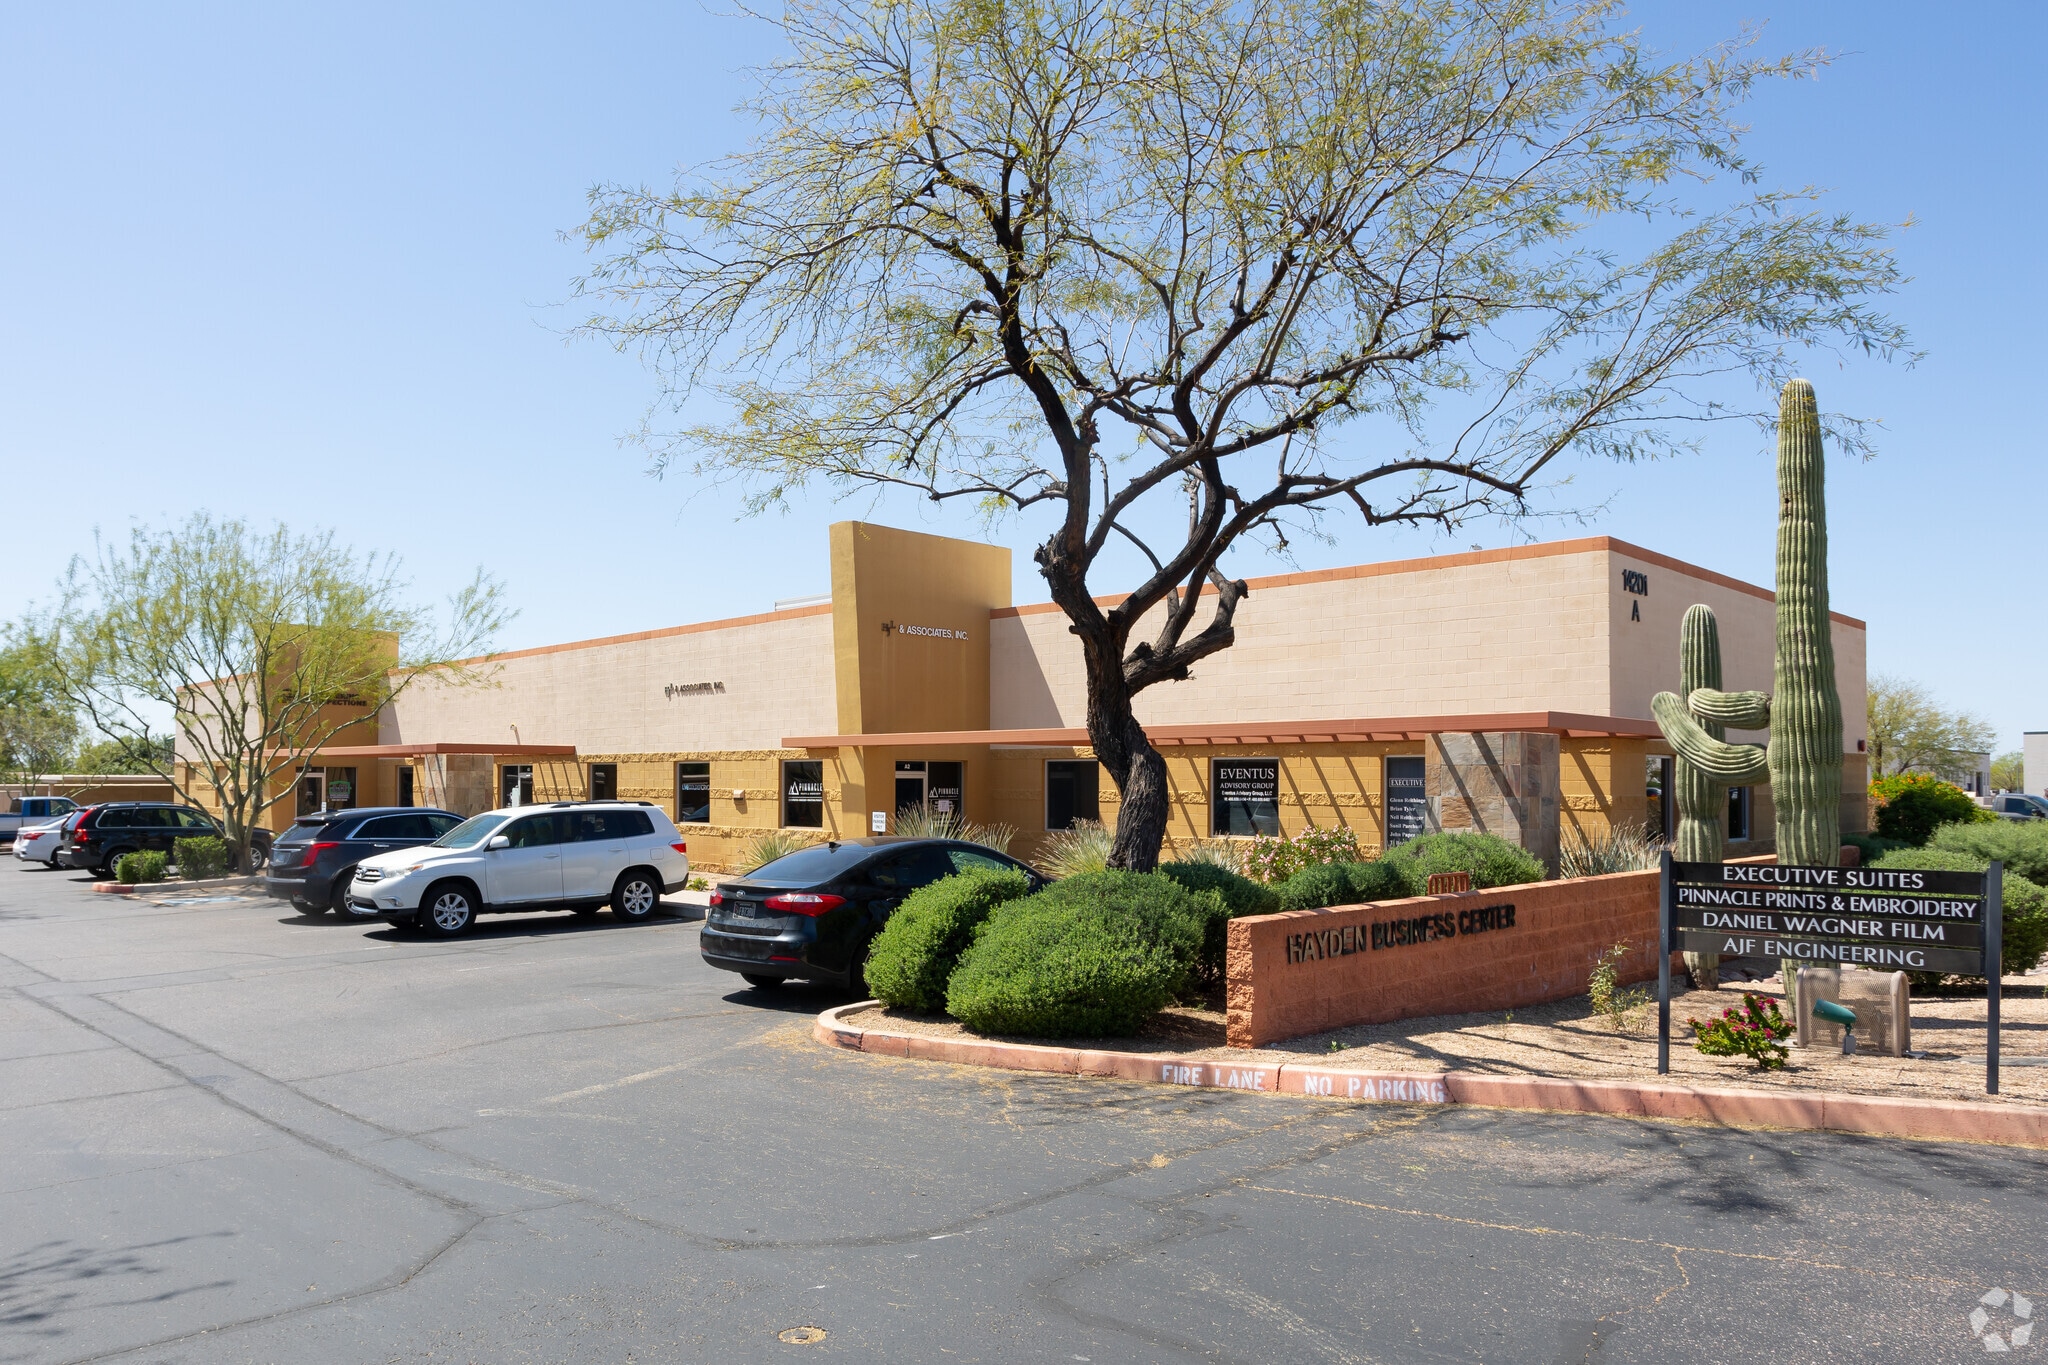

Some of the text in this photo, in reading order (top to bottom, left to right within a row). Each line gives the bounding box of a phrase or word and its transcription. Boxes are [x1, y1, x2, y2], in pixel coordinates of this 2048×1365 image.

[1622, 569, 1648, 596] 14201
[1631, 600, 1640, 622] A
[899, 624, 904, 634] &
[906, 625, 953, 639] ASSOCIATES,
[1220, 768, 1275, 779] EVENTUS
[799, 782, 822, 792] PINNACLE
[938, 787, 959, 795] PINNACLE
[1723, 866, 1924, 889] EXECUTIVE SUITES
[1678, 887, 1977, 918] PINNACLE PRINTS & EMBROIDERY
[1287, 903, 1517, 965] HAYDEN BUSINESS CENTER
[1702, 912, 1945, 941] DANIEL WAGNER FILM
[1723, 937, 1925, 967] AJF ENGINEERING
[1162, 1064, 1446, 1103] FIRE LANE NO PARKING
